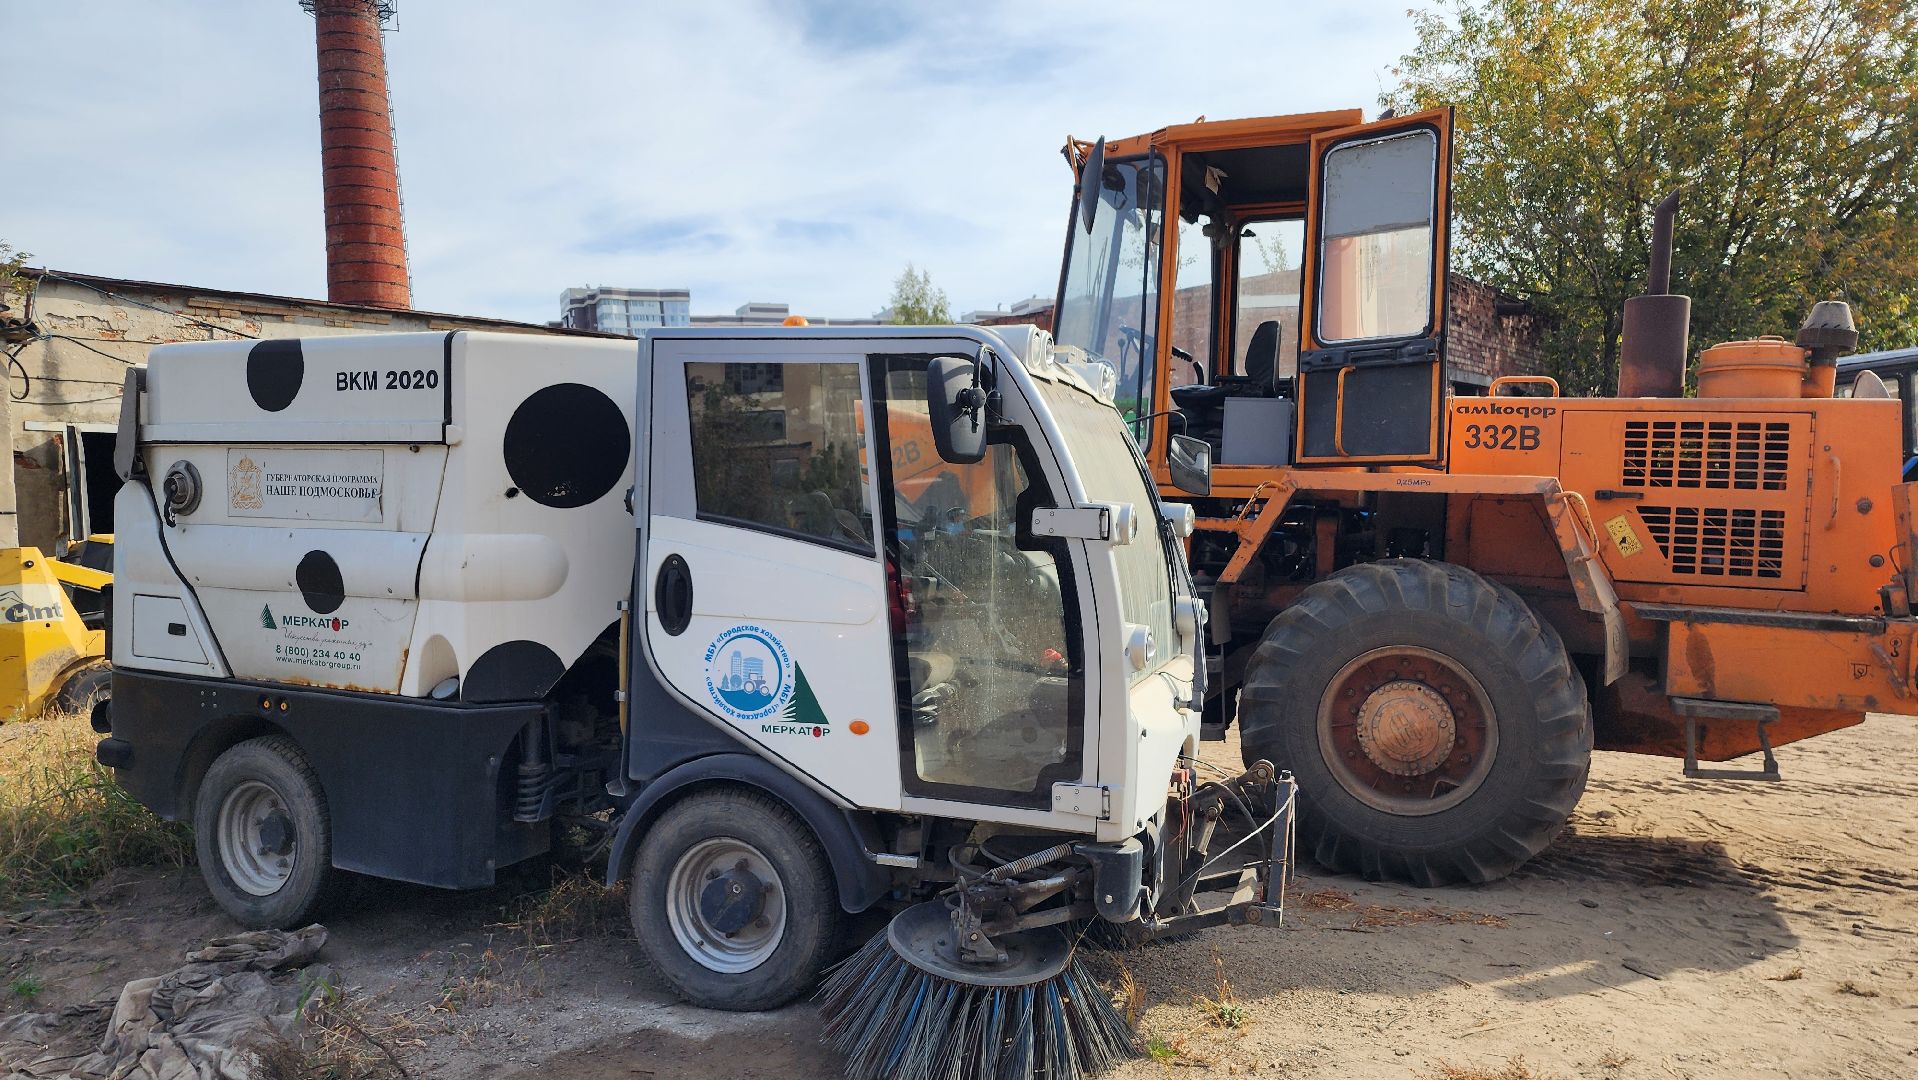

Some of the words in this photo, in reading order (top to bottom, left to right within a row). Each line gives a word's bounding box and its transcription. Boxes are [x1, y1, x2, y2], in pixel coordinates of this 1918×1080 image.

[336, 370, 378, 391] ВКМ
[385, 369, 439, 390] 2020
[1464, 424, 1541, 451] 332В
[266, 473, 330, 483] ГУБЕРНАТОРСКАЯ
[332, 475, 378, 484] ПРОГРАММА
[266, 485, 297, 496] НАШЕ
[299, 486, 378, 499] ПОДМОСКОВЬЕ
[275, 644, 282, 654] 8
[285, 645, 309, 658] (800)
[312, 649, 331, 659] 234
[333, 651, 346, 660] 40
[349, 653, 361, 662] 40
[704, 642, 717, 663] МБУ
[779, 683, 792, 704] МБУ
